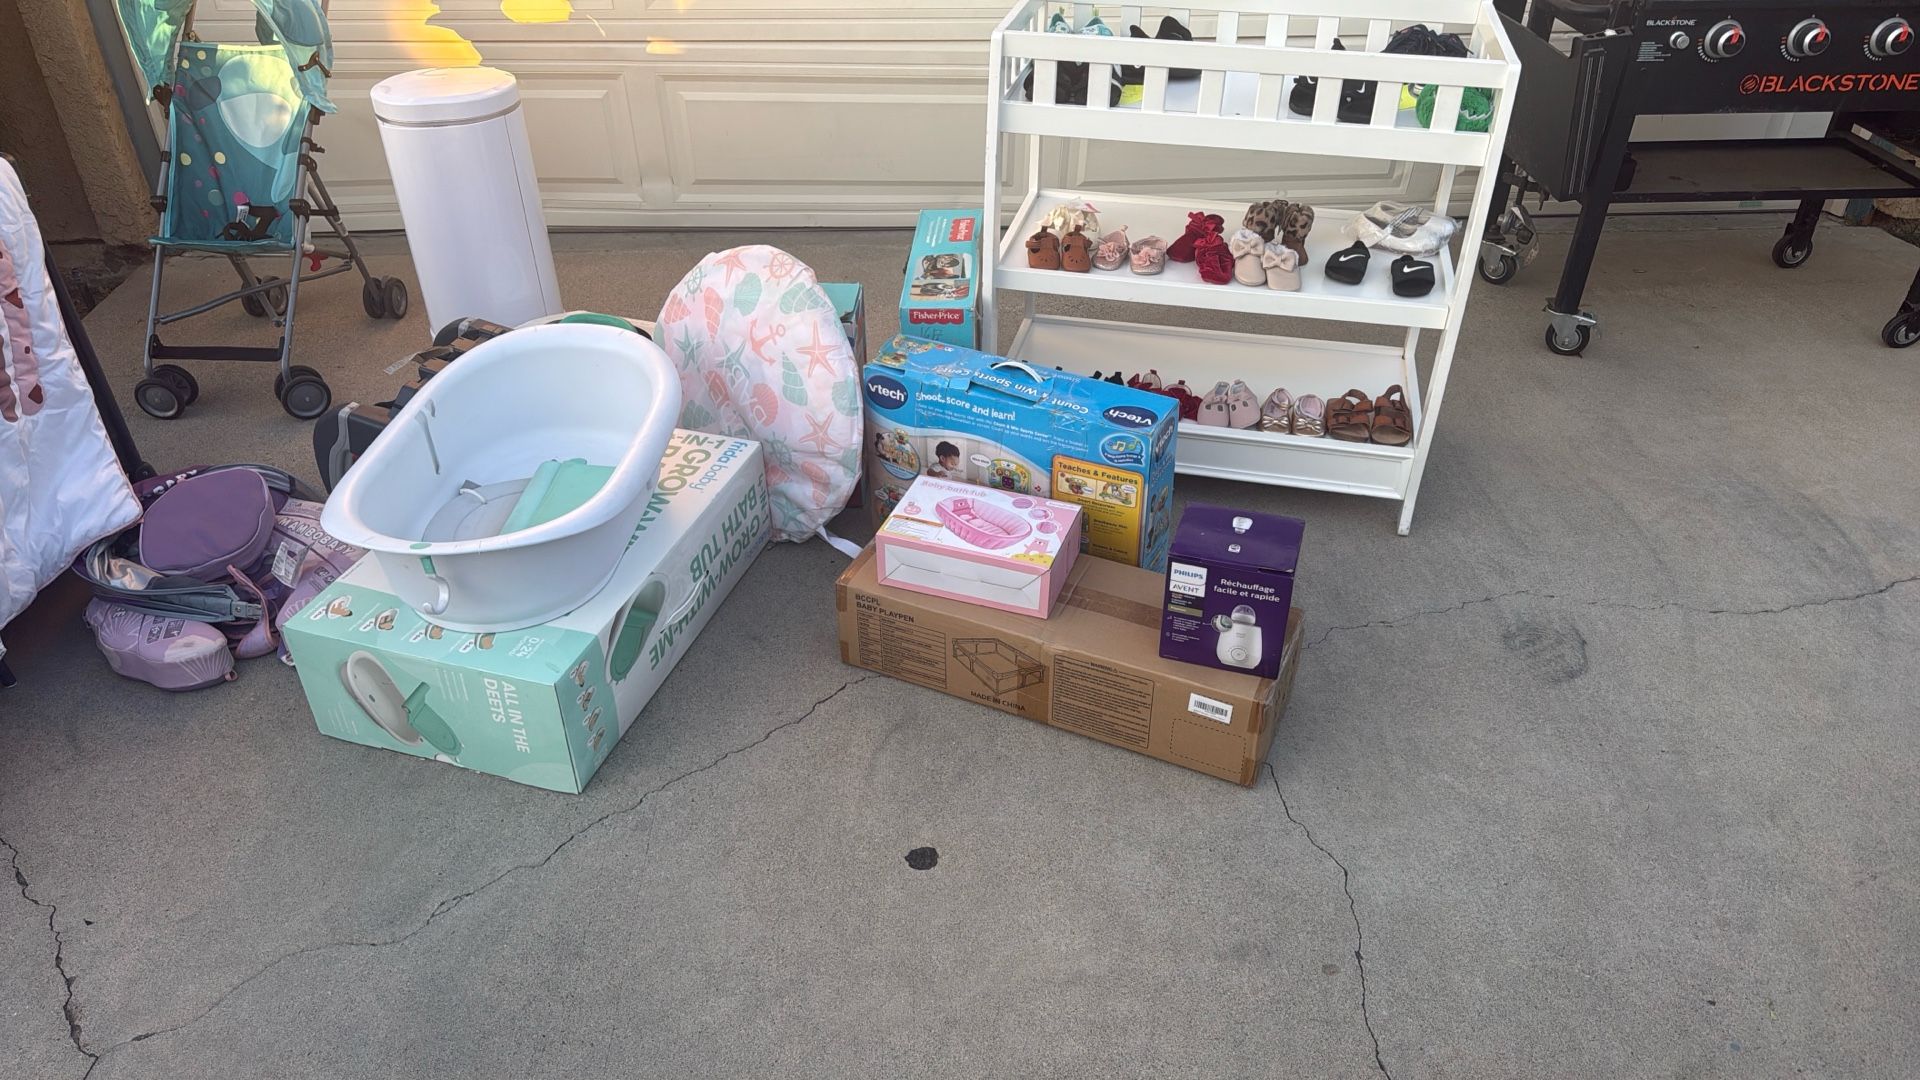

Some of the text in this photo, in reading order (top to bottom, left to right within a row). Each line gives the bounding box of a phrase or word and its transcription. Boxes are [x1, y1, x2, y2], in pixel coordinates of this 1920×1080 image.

[1758, 73, 1920, 93] BLACKSTONE
[913, 311, 961, 320] Fisher-Price
[974, 370, 1012, 387] Sports
[868, 383, 905, 401] vtech
[1014, 383, 1038, 395] Win
[946, 395, 971, 409] score
[971, 404, 989, 416] and
[991, 408, 1016, 421] learn!
[1051, 398, 1089, 414] Count
[1107, 408, 1152, 426] vtech
[672, 433, 726, 449] -IN-1
[689, 441, 748, 491] frida baby
[1058, 462, 1091, 475] Teaches
[1101, 472, 1138, 485] Features
[721, 484, 757, 545] BATH
[689, 534, 722, 585] TUB
[1173, 568, 1204, 580] PHILIPS
[1172, 583, 1200, 594] AVENT
[1213, 585, 1238, 596] facile
[1250, 592, 1281, 603] rapide
[1220, 578, 1275, 594] Réchauffage
[856, 601, 915, 623] BABY PLAYPEN
[483, 678, 506, 723] DEETS
[970, 690, 992, 702] MADE
[1002, 700, 1026, 711] CHINA
[501, 680, 531, 754] ALL IN THE
